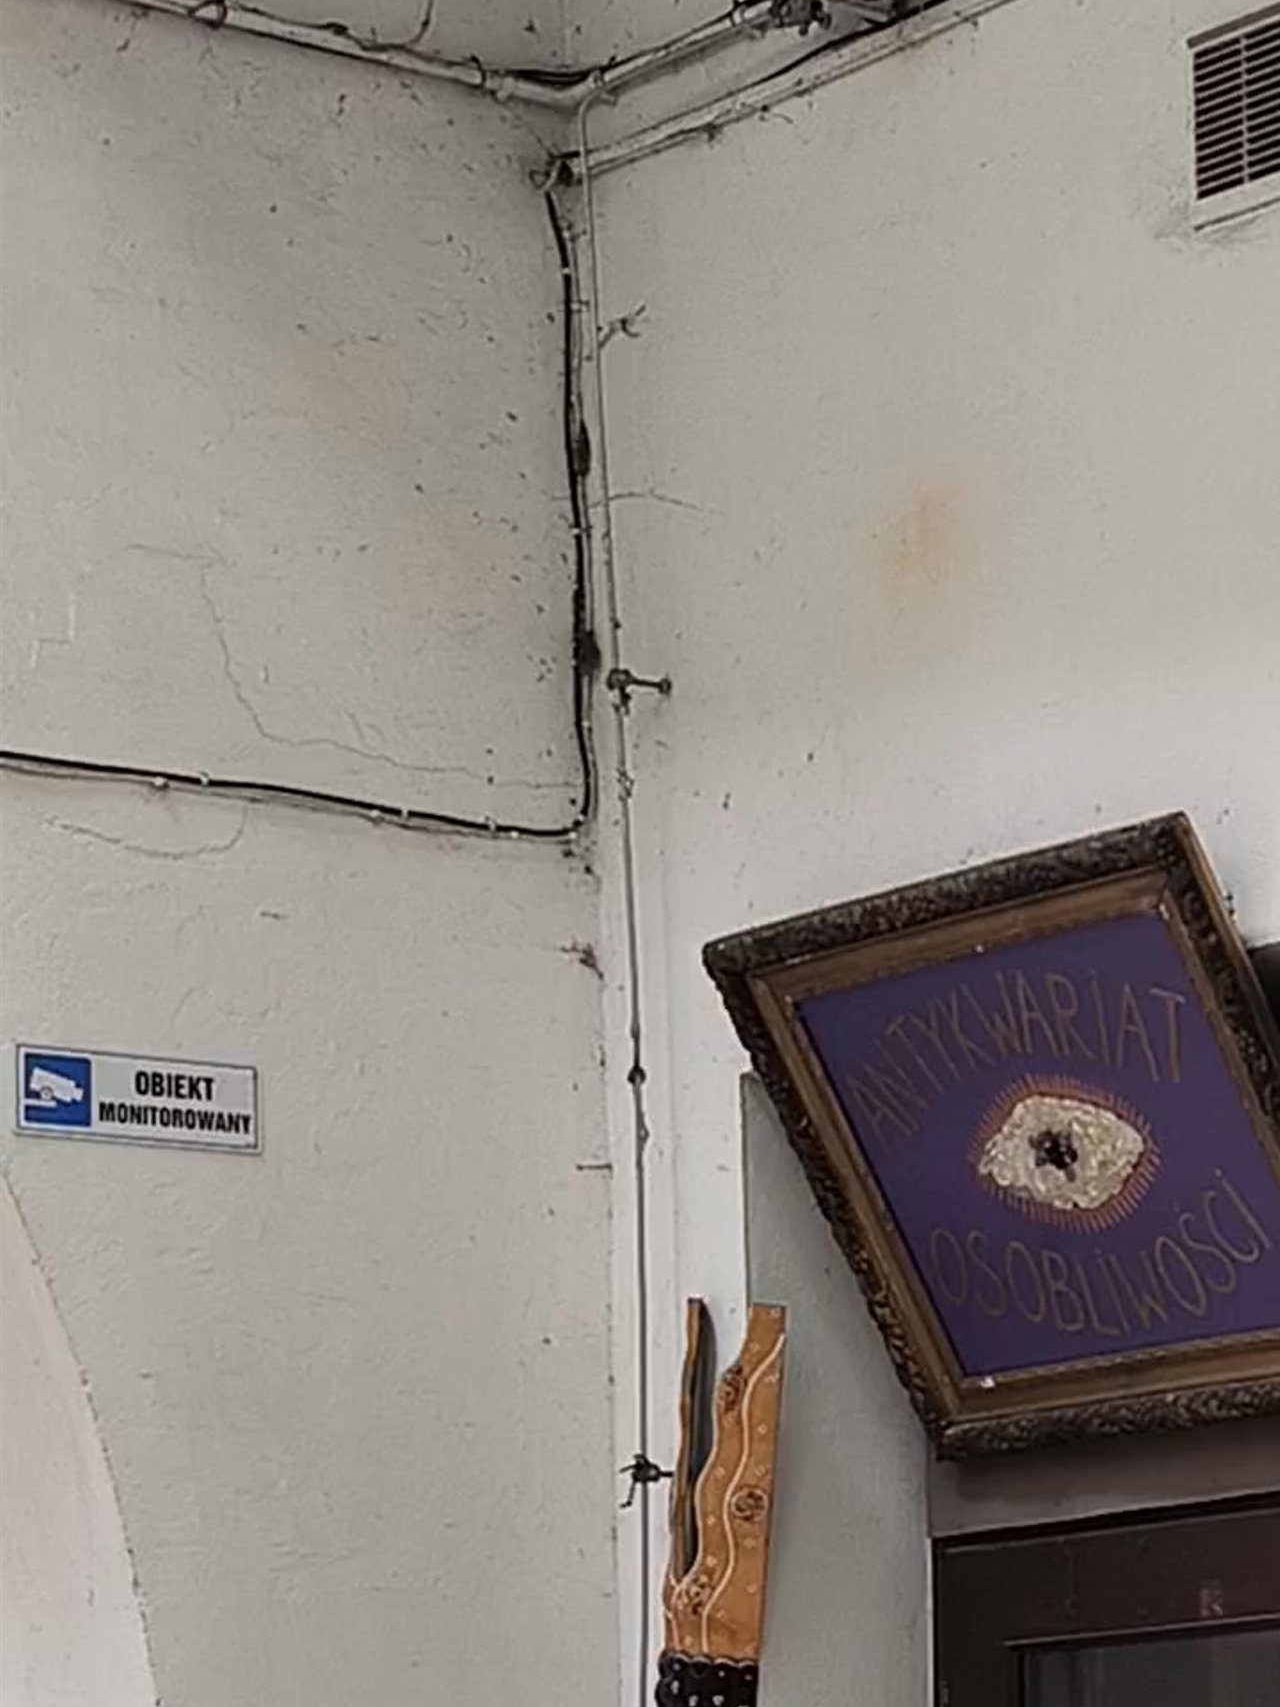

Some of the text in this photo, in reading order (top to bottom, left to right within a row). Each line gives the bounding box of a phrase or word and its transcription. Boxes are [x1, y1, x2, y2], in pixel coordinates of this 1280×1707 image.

[134, 1069, 215, 1102] OBIEKT
[844, 967, 1187, 1153] ANTYKWARIAT
[98, 1101, 252, 1135] MONITOROWANY
[928, 1166, 1274, 1337] OSOBLIWOŚCI
